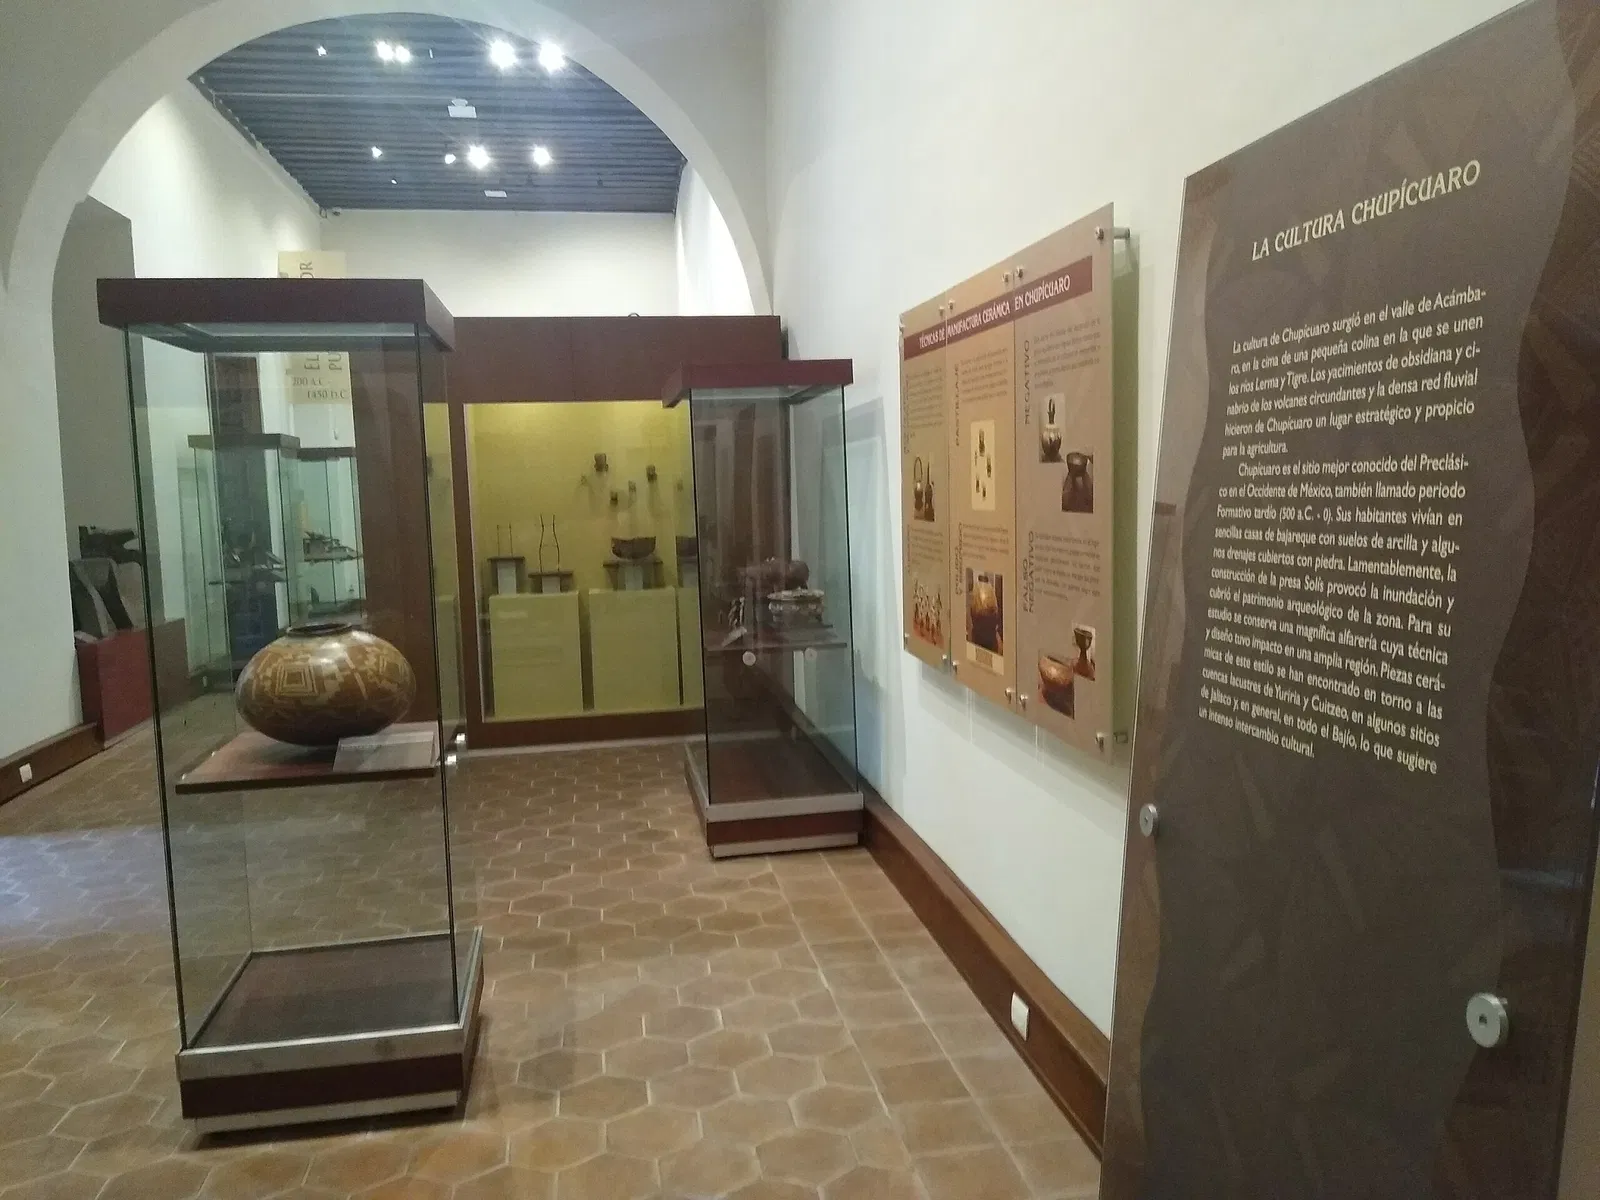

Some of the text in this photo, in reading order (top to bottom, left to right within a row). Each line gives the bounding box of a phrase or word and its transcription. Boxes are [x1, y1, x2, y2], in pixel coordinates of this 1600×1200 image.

[1252, 159, 1481, 261] LA CULTURA CHUPÍCUARO
[919, 275, 1070, 349] TÉCNICAS DE MANUFACTURA CERÁMICA EN CHUPÍCUARO
[1270, 332, 1280, 345] de
[1332, 311, 1360, 333] surgió
[1364, 312, 1375, 325] en
[1379, 304, 1388, 321] el
[1392, 300, 1414, 319] valle
[1418, 296, 1431, 313] de
[1262, 316, 1483, 369] cima de una pequeña colina en la que se unen
[1256, 341, 1480, 391] Lerma y Tigre. Los yacimientos de obsidiana y ci-
[1261, 368, 1478, 411] los volcanes circundantes y la densa red fluvial
[1255, 419, 1264, 433] de
[1316, 416, 1326, 428] un
[1330, 412, 1352, 429] lugar
[1356, 404, 1411, 425] estratégico
[1415, 405, 1422, 423] y
[1425, 398, 1474, 422] propicio
[1282, 464, 1291, 475] es
[1293, 460, 1300, 474] el
[1302, 460, 1320, 474] sitio
[1322, 459, 1349, 478] mejor
[1352, 455, 1398, 473] conocido
[1401, 454, 1417, 472] del
[1247, 483, 1285, 497] Occidente
[1288, 482, 1298, 497] de
[1335, 481, 1372, 498] también
[1376, 481, 1416, 498] llamado
[1298, 505, 1313, 520] a.C.
[1323, 508, 1333, 525] 0).
[1336, 506, 1351, 522] Sus
[1356, 506, 1406, 524] habitantes
[1412, 507, 1442, 525] vivían
[1448, 512, 1462, 526] en
[1265, 526, 1460, 558] de bajareque con suelos de arcilla y algu-
[1297, 554, 1312, 567] con
[1315, 554, 1345, 572] piedra.
[1348, 556, 1444, 582] Lamentablemente,
[1447, 563, 1456, 582] la
[1258, 570, 1267, 584] de
[1327, 581, 1366, 597] provocó
[1371, 582, 1379, 600] la
[1383, 585, 1442, 609] inundación
[1447, 596, 1454, 614] y
[1242, 592, 1450, 637] patrimonio arqueológico de la zona. Para su
[1205, 628, 1210, 640] y
[1252, 635, 1282, 654] impacto
[1285, 645, 1294, 657] en
[1297, 648, 1311, 661] una
[1314, 651, 1342, 670] amplia
[1381, 661, 1412, 684] Piezas
[1280, 621, 1293, 634] una
[1381, 639, 1404, 659] cuya
[1408, 641, 1448, 665] técnica
[1264, 682, 1273, 697] de
[1303, 696, 1309, 711] y
[1312, 694, 1348, 722] Cuitzeo,
[1352, 710, 1363, 724] en
[1367, 712, 1406, 737] algunos
[1410, 725, 1440, 747] sitios
[1277, 665, 1442, 720] se han encontrado en torno a las
[1235, 716, 1279, 744] intercambio
[1281, 735, 1314, 758] cultural.
[1284, 714, 1294, 726] en
[1297, 717, 1317, 734] todo
[1321, 723, 1329, 738] el
[1361, 733, 1370, 751] lo
[1374, 742, 1393, 760] que
[1397, 750, 1437, 774] sugiere
